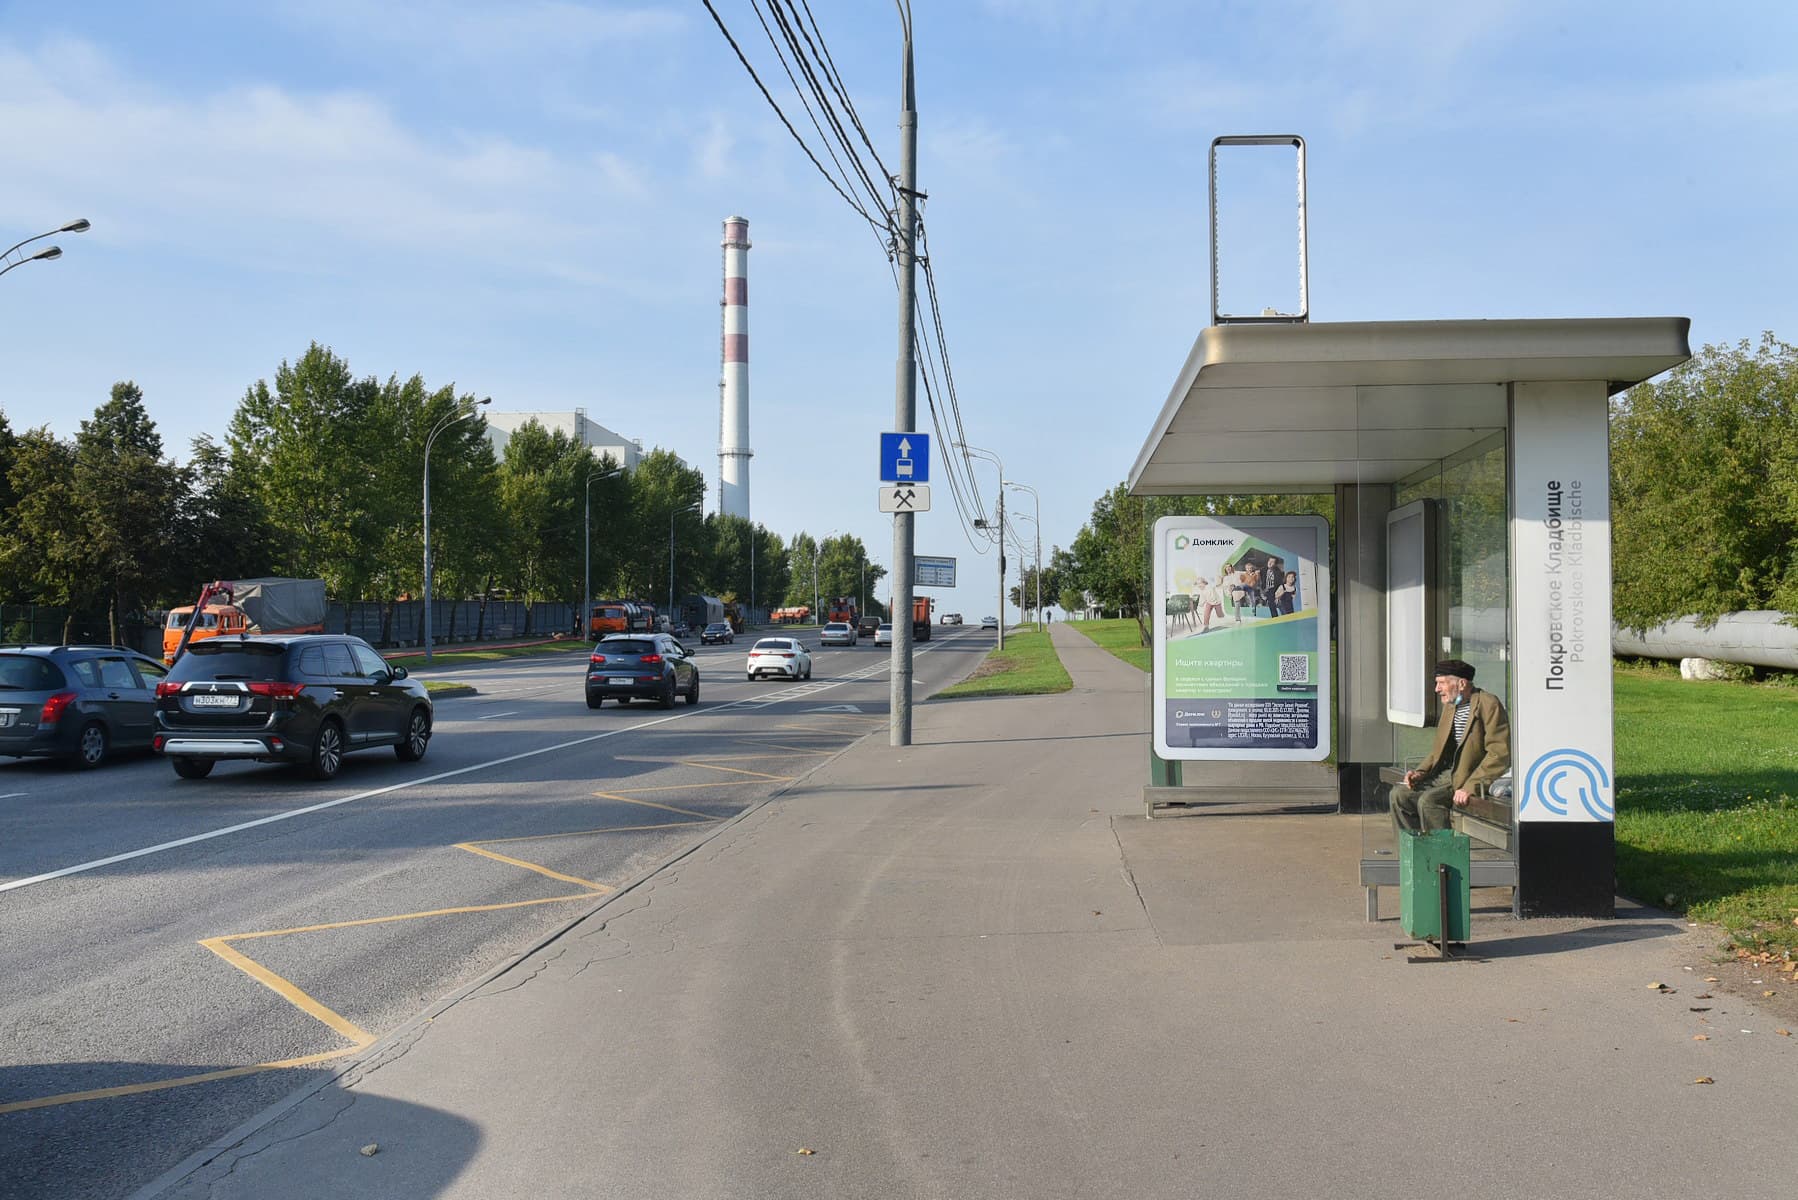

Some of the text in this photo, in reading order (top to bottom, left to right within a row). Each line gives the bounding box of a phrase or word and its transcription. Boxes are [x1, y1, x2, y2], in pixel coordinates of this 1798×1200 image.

[1192, 538, 1234, 547] Домклик
[1543, 480, 1567, 690] Покровское Кладбище
[1566, 480, 1584, 663] Pokrovskoe Kladbische
